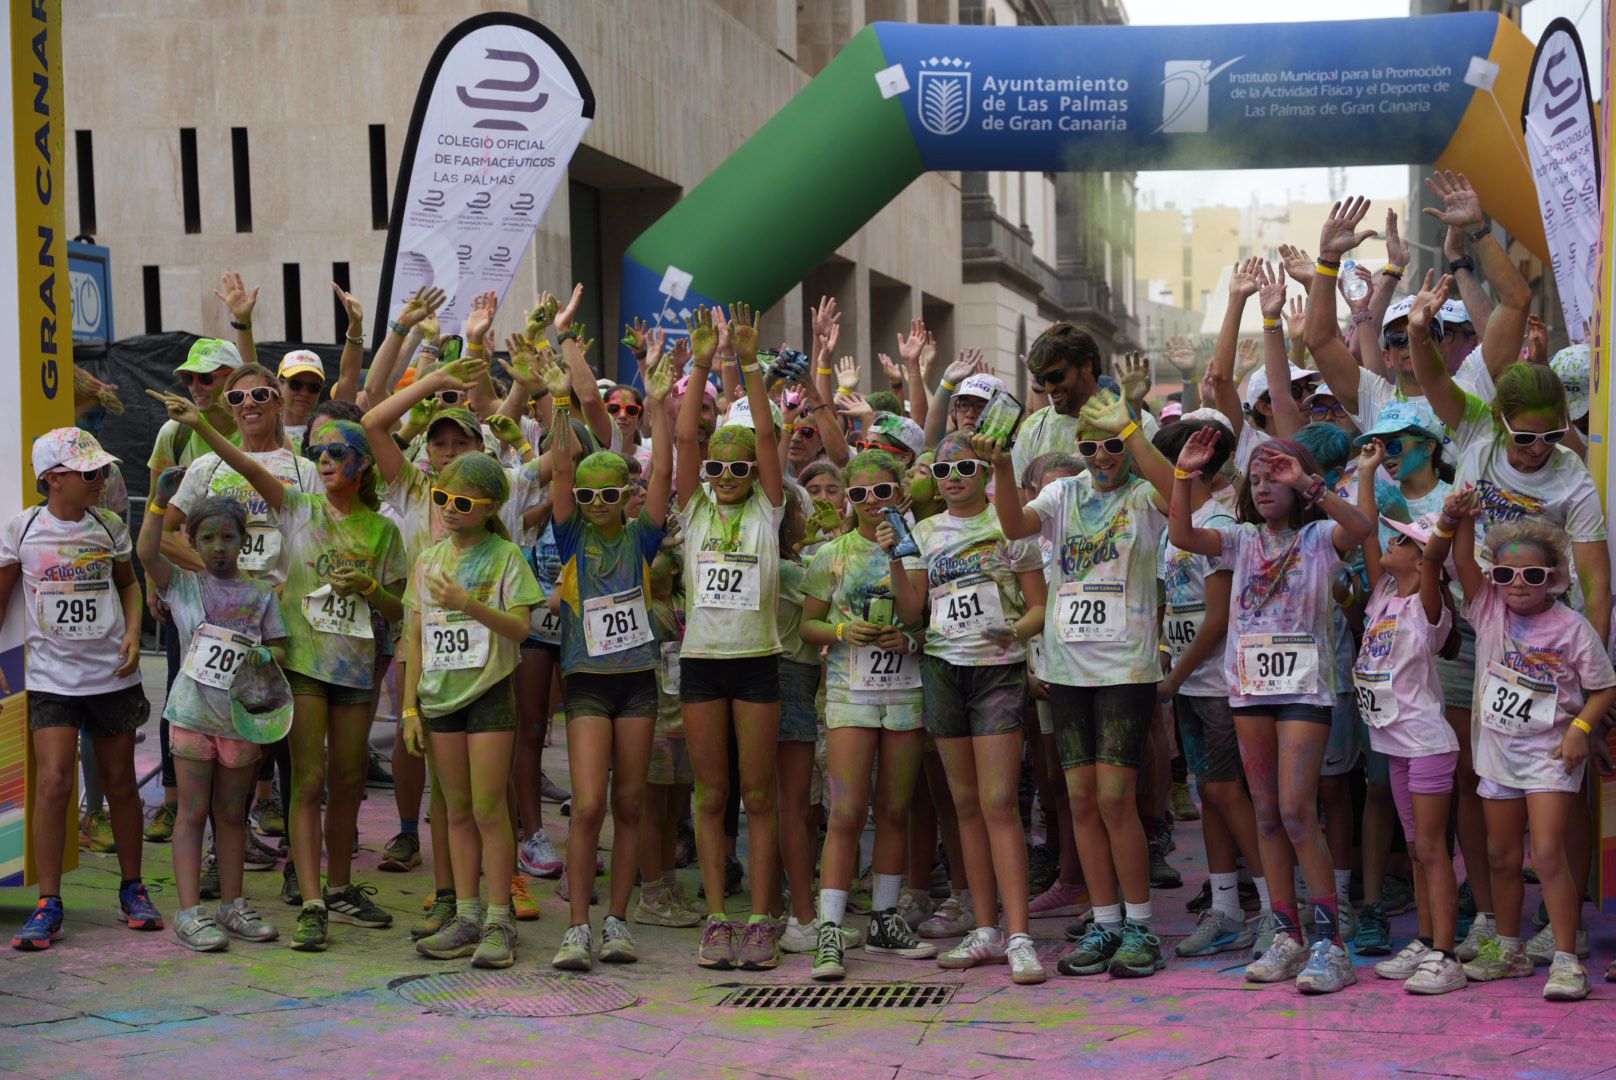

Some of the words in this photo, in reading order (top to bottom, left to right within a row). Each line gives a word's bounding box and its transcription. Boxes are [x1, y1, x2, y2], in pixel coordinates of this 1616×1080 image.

[982, 75, 1129, 95] Ayuntamiento
[1229, 71, 1278, 83] Instituto
[1280, 69, 1339, 84] Municipal
[1341, 69, 1369, 83] para
[1372, 68, 1382, 79] la
[1386, 64, 1452, 79] Promoción
[1230, 87, 1247, 99] de
[1249, 86, 1260, 98] la
[1262, 85, 1318, 98] Actividad
[1355, 86, 1363, 99] y
[1366, 83, 1377, 95] el
[1380, 82, 1431, 96] Deporte
[1433, 81, 1450, 92] de
[982, 95, 1006, 111] de
[1018, 96, 1048, 111] Las
[1060, 95, 1128, 111] Palmas
[1244, 104, 1266, 118] Las
[1270, 103, 1317, 116] Palmas
[1320, 102, 1338, 115] de
[1341, 101, 1375, 115] Gran
[1379, 99, 1431, 113] Canaria
[982, 115, 1004, 130] de
[1009, 116, 1053, 131] Gran
[1058, 115, 1127, 131] Canaria
[437, 134, 494, 149] COLEGIO
[496, 139, 545, 150] OFICIAL
[434, 153, 452, 164] DE
[454, 156, 556, 168] FARMACÉUTICOS
[433, 172, 459, 183] LAS
[463, 174, 516, 185] PALMAS
[38, 224, 60, 401] GRAN
[706, 568, 743, 593] 292
[55, 598, 98, 624] 295
[321, 595, 356, 623] 431
[946, 592, 984, 621] 451
[1069, 600, 1107, 625] 228
[602, 607, 639, 638] 261
[1168, 620, 1196, 644] 446
[433, 628, 469, 654] 239
[870, 650, 903, 675] 227
[1256, 652, 1298, 678] 307
[1492, 686, 1534, 723] 324
